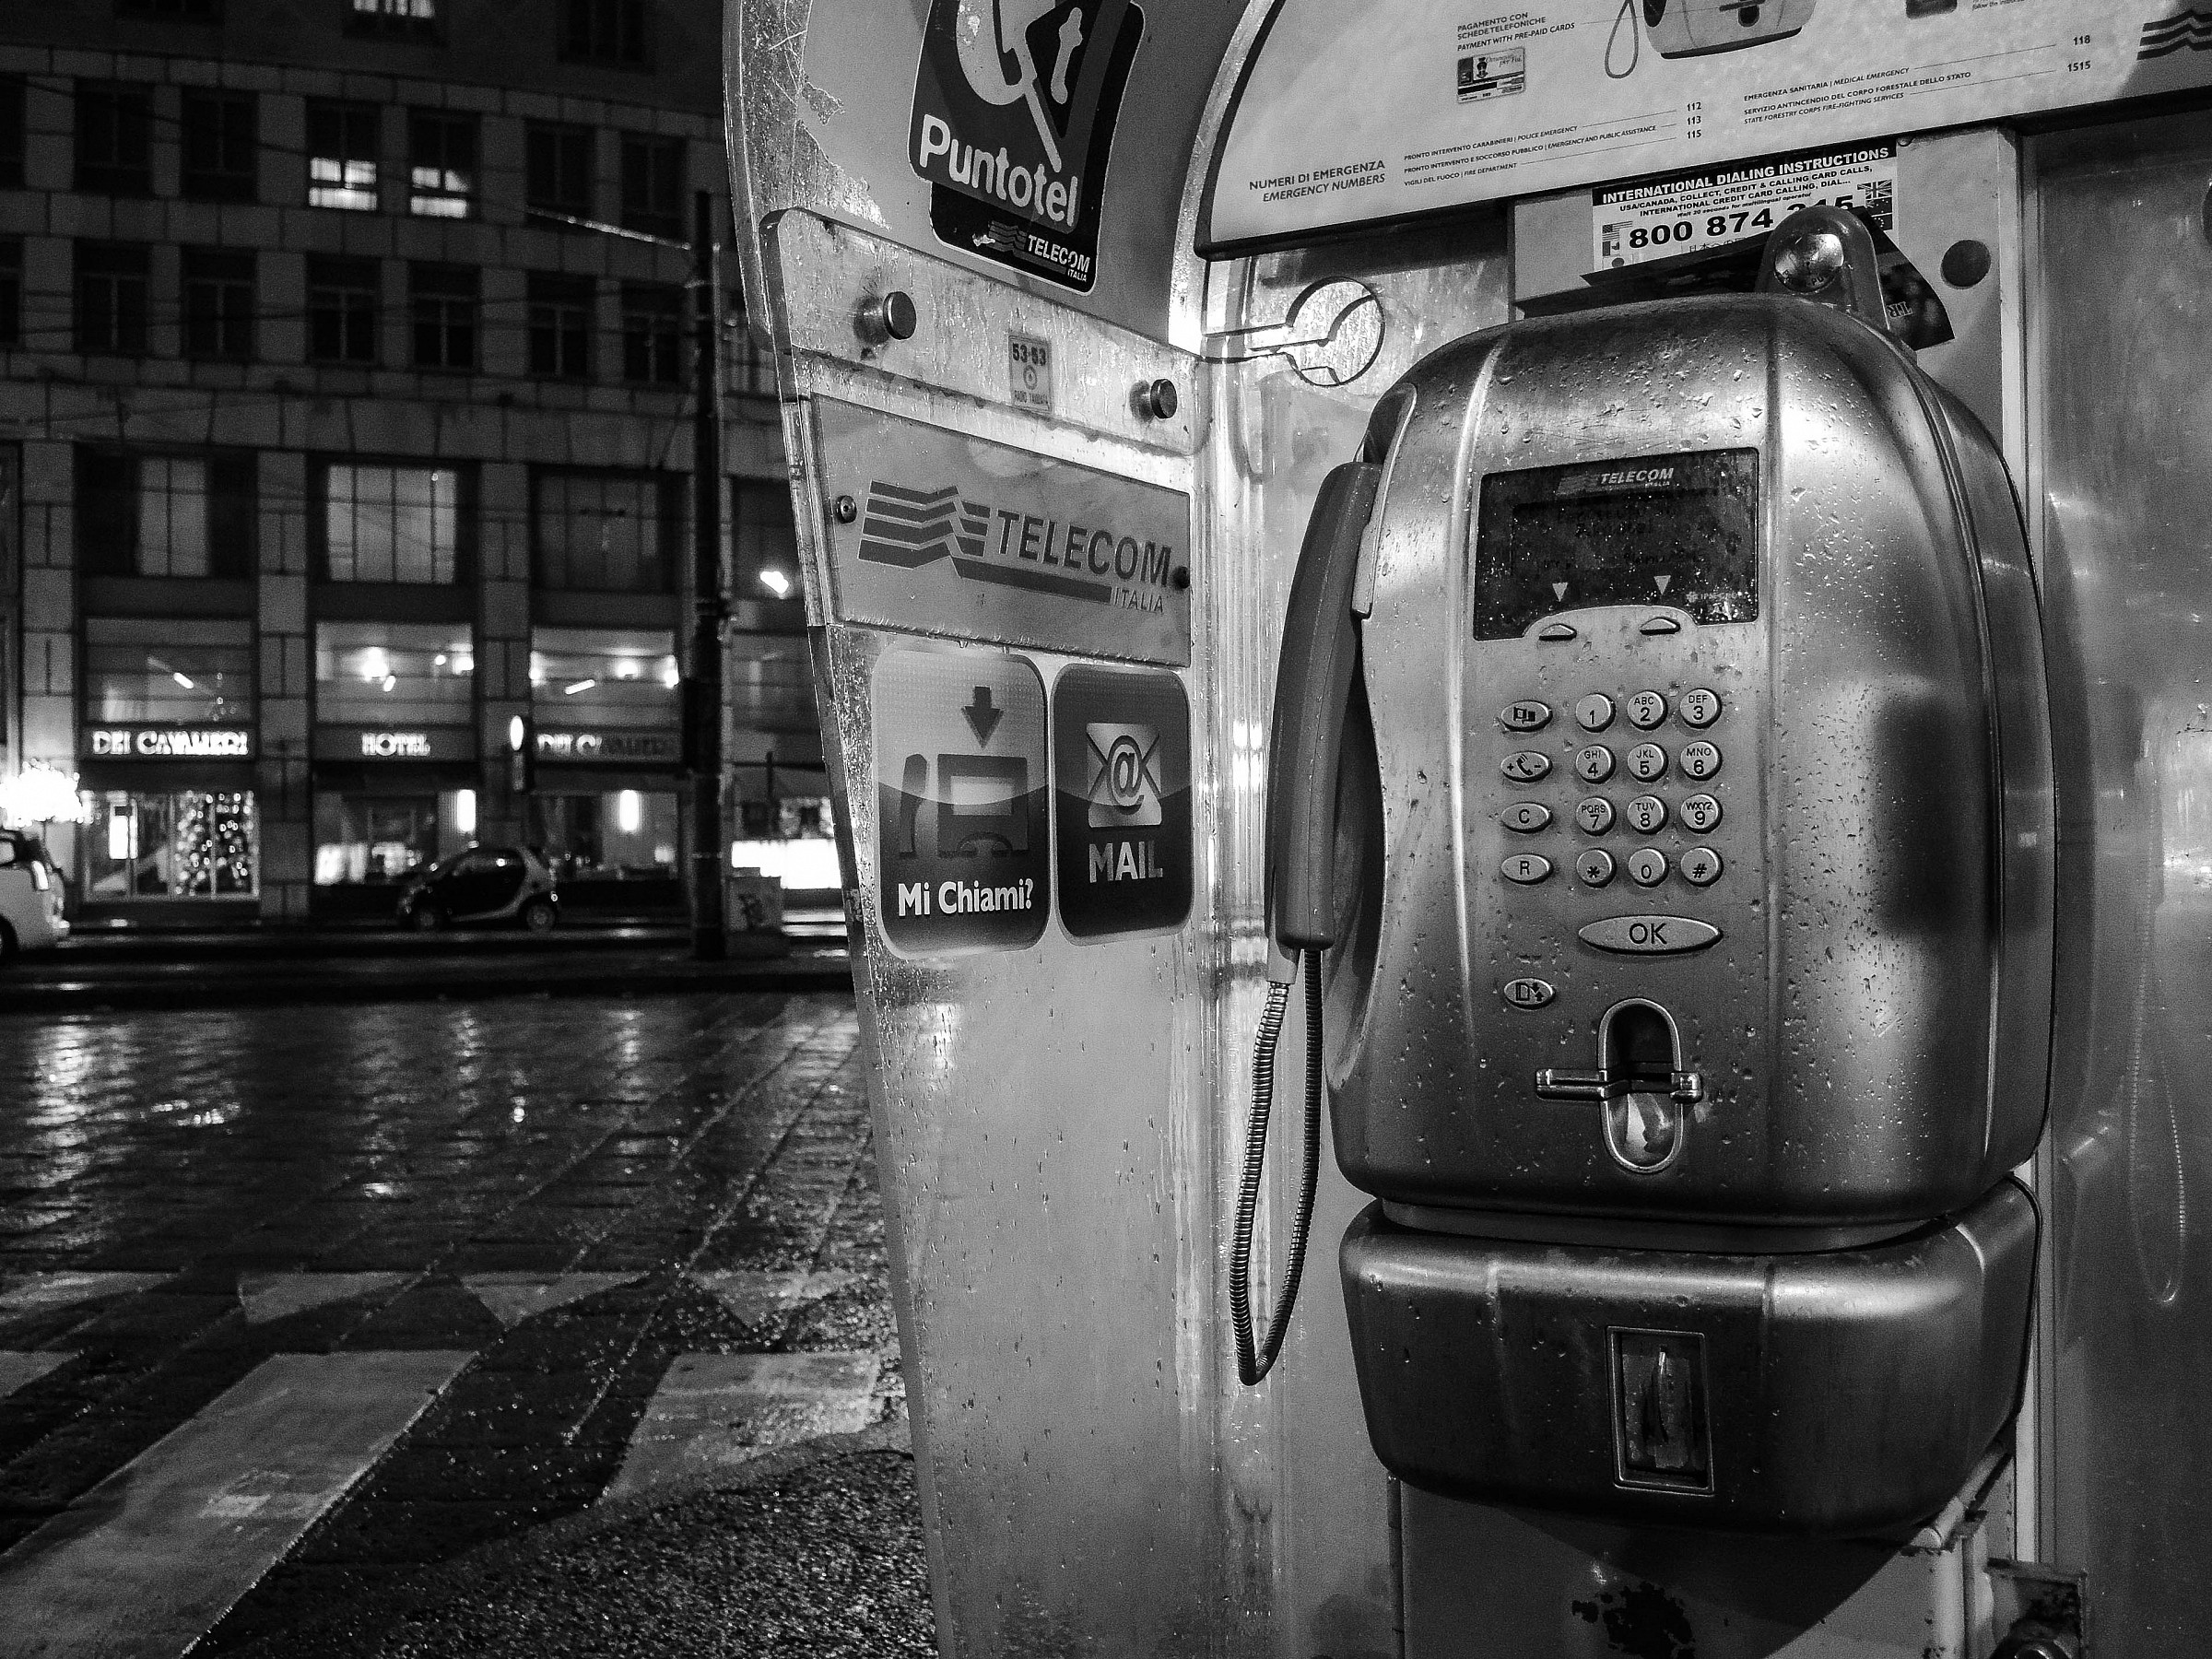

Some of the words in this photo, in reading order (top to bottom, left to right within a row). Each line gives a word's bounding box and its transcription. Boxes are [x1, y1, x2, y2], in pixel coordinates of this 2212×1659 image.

[1457, 17, 1507, 32] PAGAMENTO
[1510, 12, 1528, 21] CON
[1457, 28, 1488, 40] SCHEDE
[1489, 17, 1547, 33] TELEFONICHE
[1457, 39, 1491, 52] PAYMENT
[1492, 34, 1512, 44] WITH
[1514, 28, 1548, 41] PRE-PAID
[1549, 22, 1575, 33] CARDS
[1744, 88, 1788, 101] EMERGENZA
[1789, 81, 1828, 93] SANITARIA
[1833, 76, 1865, 86] MEDICAL
[1865, 67, 1909, 80] EMERGENCY
[2073, 35, 2090, 45] 118
[1744, 116, 1763, 124] STATE
[1764, 110, 1797, 121] FORESTRY
[1798, 106, 1821, 115] CORPS
[1822, 98, 1872, 112] FIRE-FIGHTING
[1873, 92, 1904, 102] SERVICES
[2067, 60, 2091, 73] 1515
[1744, 105, 1776, 115] SERVIZIO
[1776, 96, 1830, 110] ANTINCENDIO
[1847, 88, 1874, 98] CORPO
[1876, 80, 1918, 92] FORESTALE
[1920, 76, 1945, 85] DELLO
[1947, 72, 1971, 81] STATO
[1404, 152, 1430, 160] PRONTO
[1431, 145, 1471, 157] INTERVENTO
[1472, 137, 1513, 148] CARABINIERI
[1518, 132, 1539, 141] POLICE
[1540, 125, 1577, 137] EMERGENCY
[1687, 101, 1701, 112] 112
[1404, 164, 1430, 173] PRONTO
[1430, 158, 1469, 170] INTERVENTO
[1476, 151, 1510, 161] SOCCORSO
[1511, 144, 1544, 156] PUBBLICO
[1547, 138, 1584, 149] EMERGENCY
[1599, 131, 1621, 141] PUBLIC
[1621, 125, 1656, 136] ASSISTANCE
[1687, 115, 1701, 125] 113
[1437, 172, 1460, 181] FUOCO
[1477, 162, 1517, 174] DEPARTMENT
[1687, 130, 1701, 139] 115
[920, 113, 1078, 226] Puntotel
[1249, 174, 1295, 190] NUMERI
[1298, 172, 1310, 183] DI
[1312, 160, 1385, 182] EMERGENZA
[1602, 177, 1713, 204] INTERNATIONAL
[1716, 166, 1775, 185] DIALING
[1779, 147, 1889, 175] INSTRUCTIONS
[1263, 182, 1329, 202] EMERGENCY
[1332, 173, 1385, 192] NUMBERS
[1619, 197, 1677, 212] USA/CANADA,
[1680, 190, 1722, 202] COLLECT,
[1724, 183, 1757, 194] CREDIT
[1769, 174, 1809, 187] CALLING
[1811, 171, 1837, 180] CARD
[1840, 165, 1873, 176] CALLS,
[1640, 200, 1711, 217] INTERNATIONAL
[1712, 194, 1747, 206] CREDIT
[1747, 188, 1772, 199] CARD
[1775, 182, 1818, 194] CALLING,
[1820, 179, 1851, 187] DIAL...
[1702, 206, 1730, 214] seconds
[1783, 192, 1812, 202] operator
[1629, 220, 1693, 249] 800
[1706, 207, 1774, 237] 874
[1028, 234, 1090, 273] TELECOM
[1067, 268, 1088, 282] ITALIA
[1601, 467, 1675, 485] TELECOM
[997, 509, 1172, 587] TELECOM
[1112, 587, 1164, 614] ITALIA
[1634, 696, 1654, 706] ABC
[1688, 694, 1708, 704] DEF
[1589, 710, 1595, 725] 1
[1640, 707, 1651, 723] 2
[1693, 705, 1704, 721] 3
[92, 730, 131, 755] DEI
[361, 733, 430, 756] HOTEL
[1687, 747, 1712, 757] MNO
[1583, 749, 1601, 759] GHI
[1636, 749, 1654, 759] JKL
[1587, 761, 1599, 777] 4
[1640, 760, 1650, 776] 5
[1693, 759, 1704, 775] 6
[1518, 808, 1530, 824] C
[1581, 805, 1606, 814] PQRS
[1635, 802, 1655, 812] TUV
[1686, 801, 1713, 811] WXYZ
[1589, 815, 1600, 829] 7
[1640, 813, 1651, 828] 8
[1694, 811, 1705, 826] 9
[1088, 841, 1164, 883] MAIL
[1519, 860, 1530, 875] R
[1641, 865, 1653, 878] 0
[898, 882, 931, 917] Mi
[938, 878, 1034, 915] Chiami?
[1629, 923, 1667, 945] OK
